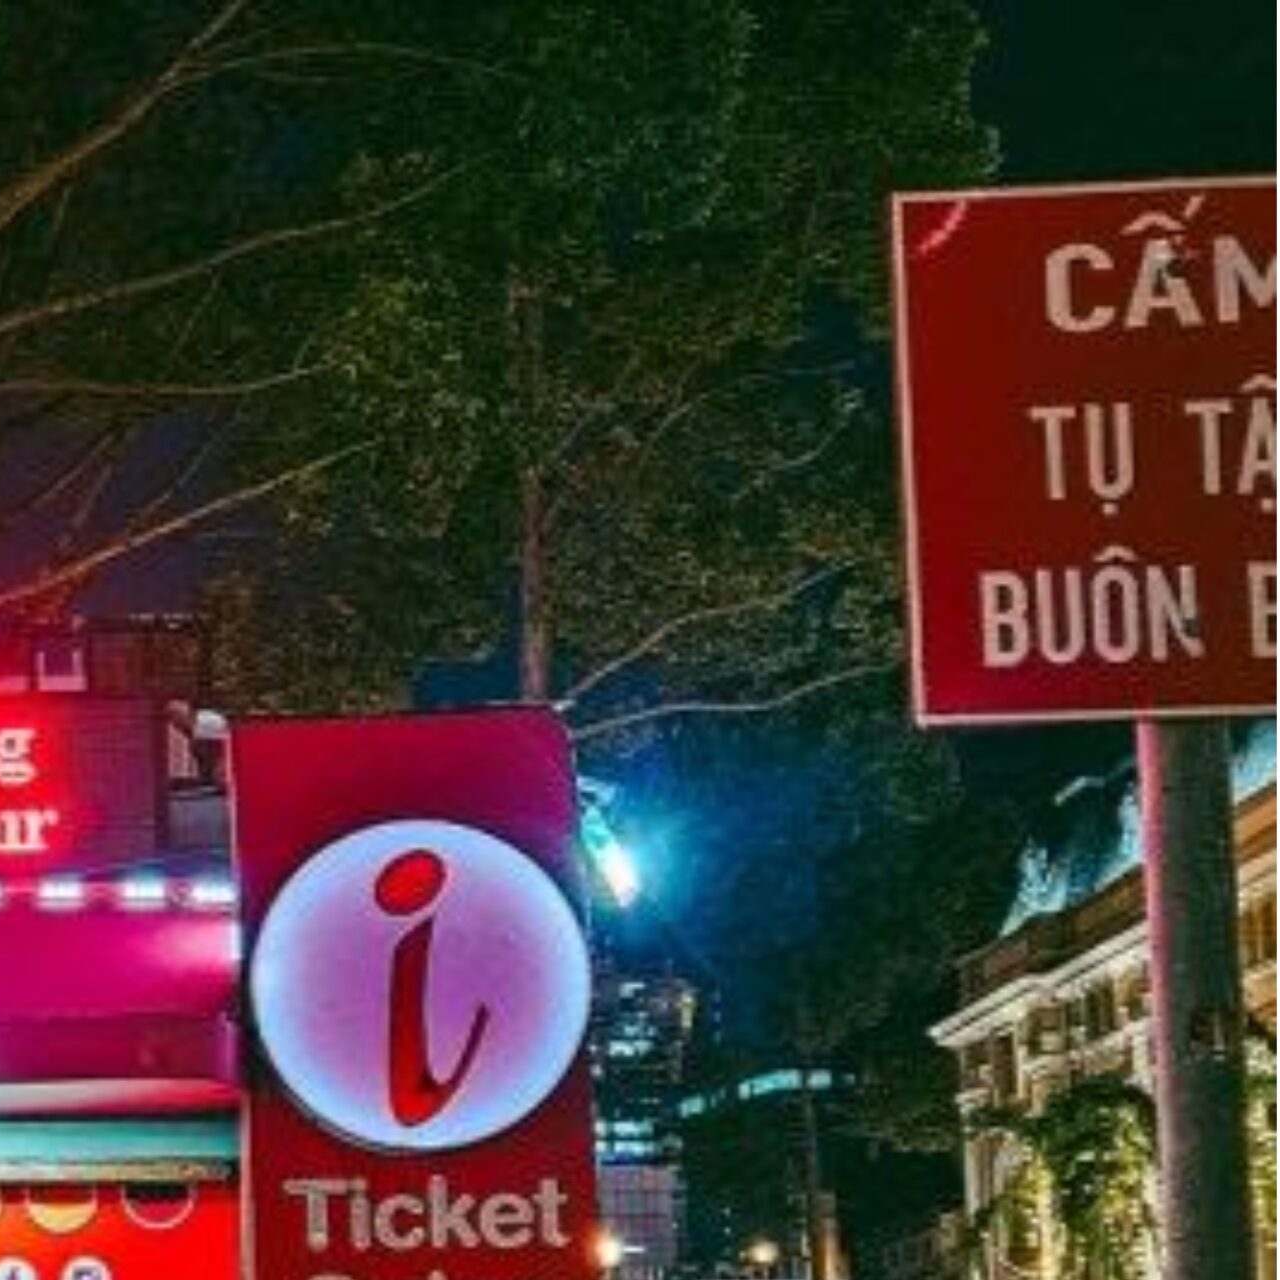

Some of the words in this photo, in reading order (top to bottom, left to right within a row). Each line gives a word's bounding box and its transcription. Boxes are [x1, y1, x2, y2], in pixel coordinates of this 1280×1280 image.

[1030, 403, 1135, 516] TỤ
[978, 545, 1204, 668] BUÔN
[282, 1174, 571, 1250] Ticket
